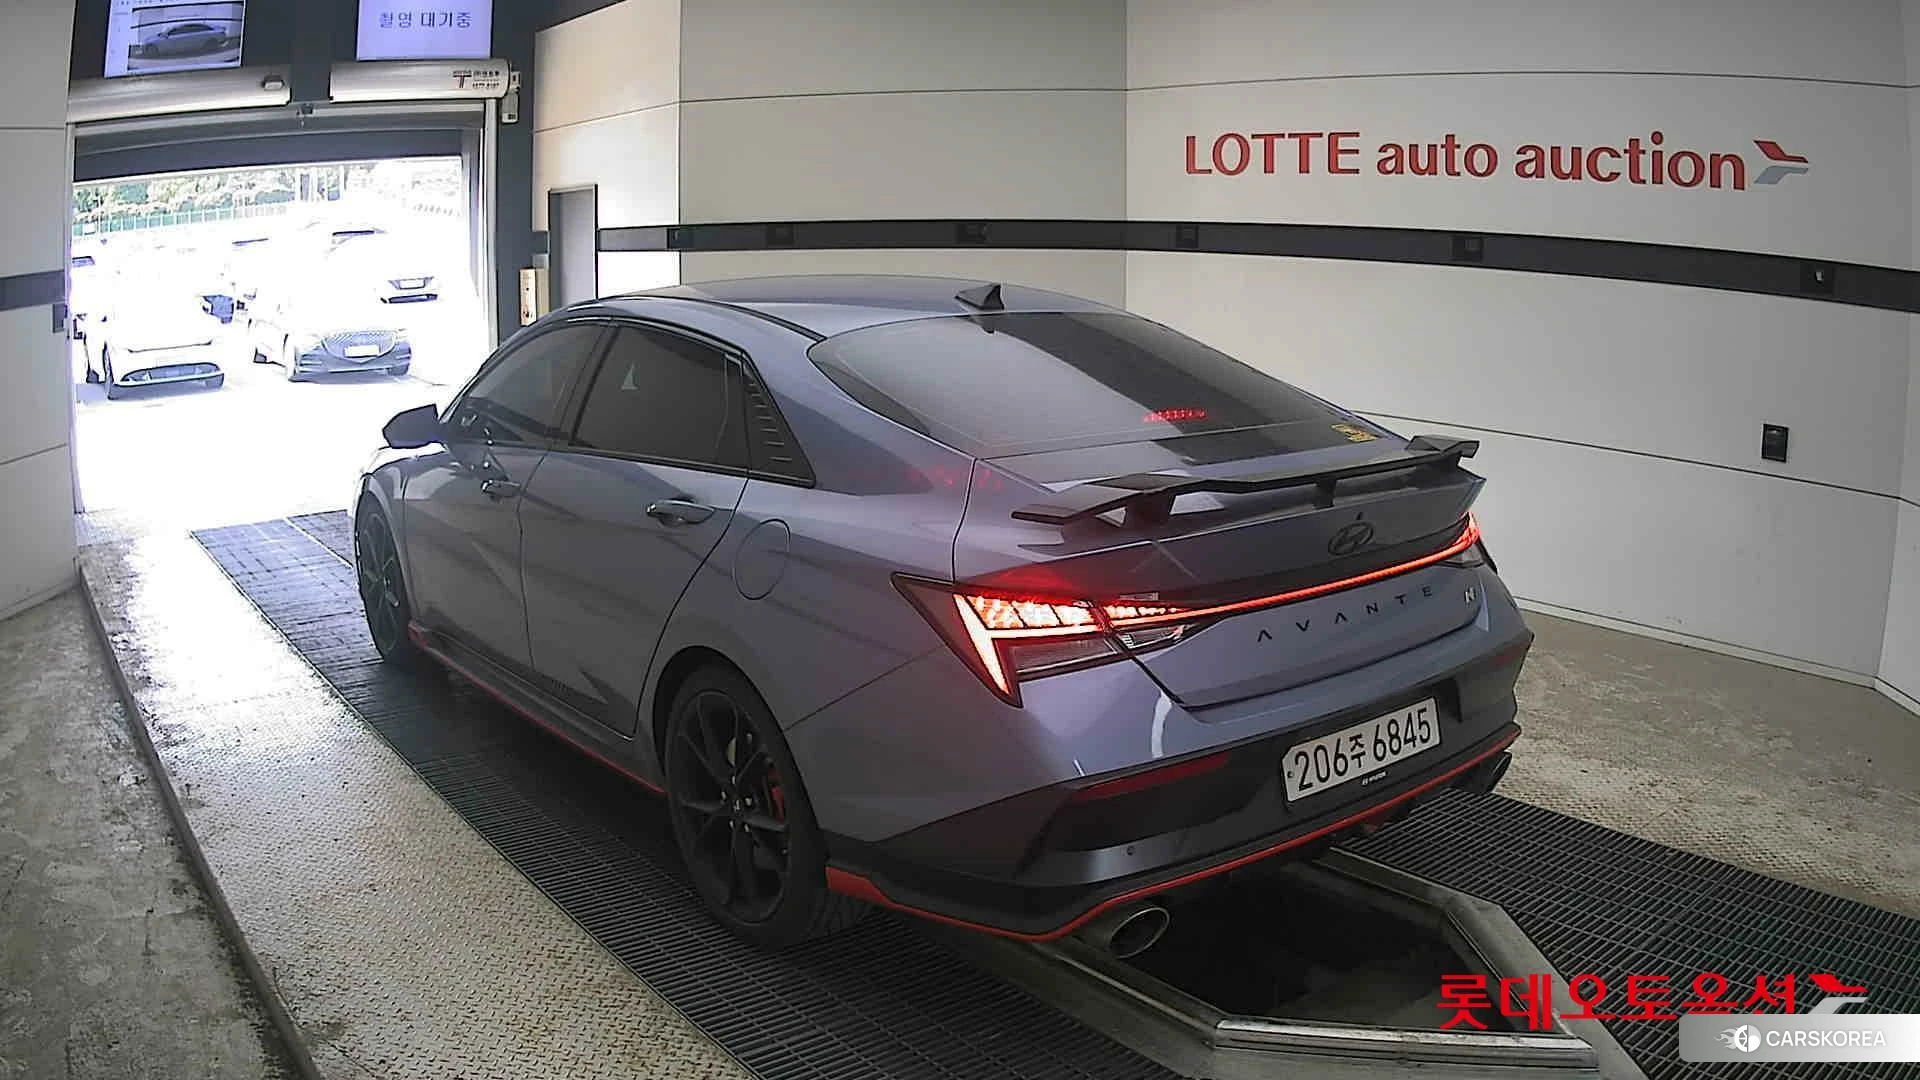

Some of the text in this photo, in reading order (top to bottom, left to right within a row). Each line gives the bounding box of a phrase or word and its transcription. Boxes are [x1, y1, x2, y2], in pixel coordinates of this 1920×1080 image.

[1185, 131, 1746, 190] LOTTE auto auction
[1257, 584, 1433, 642] AVANTE
